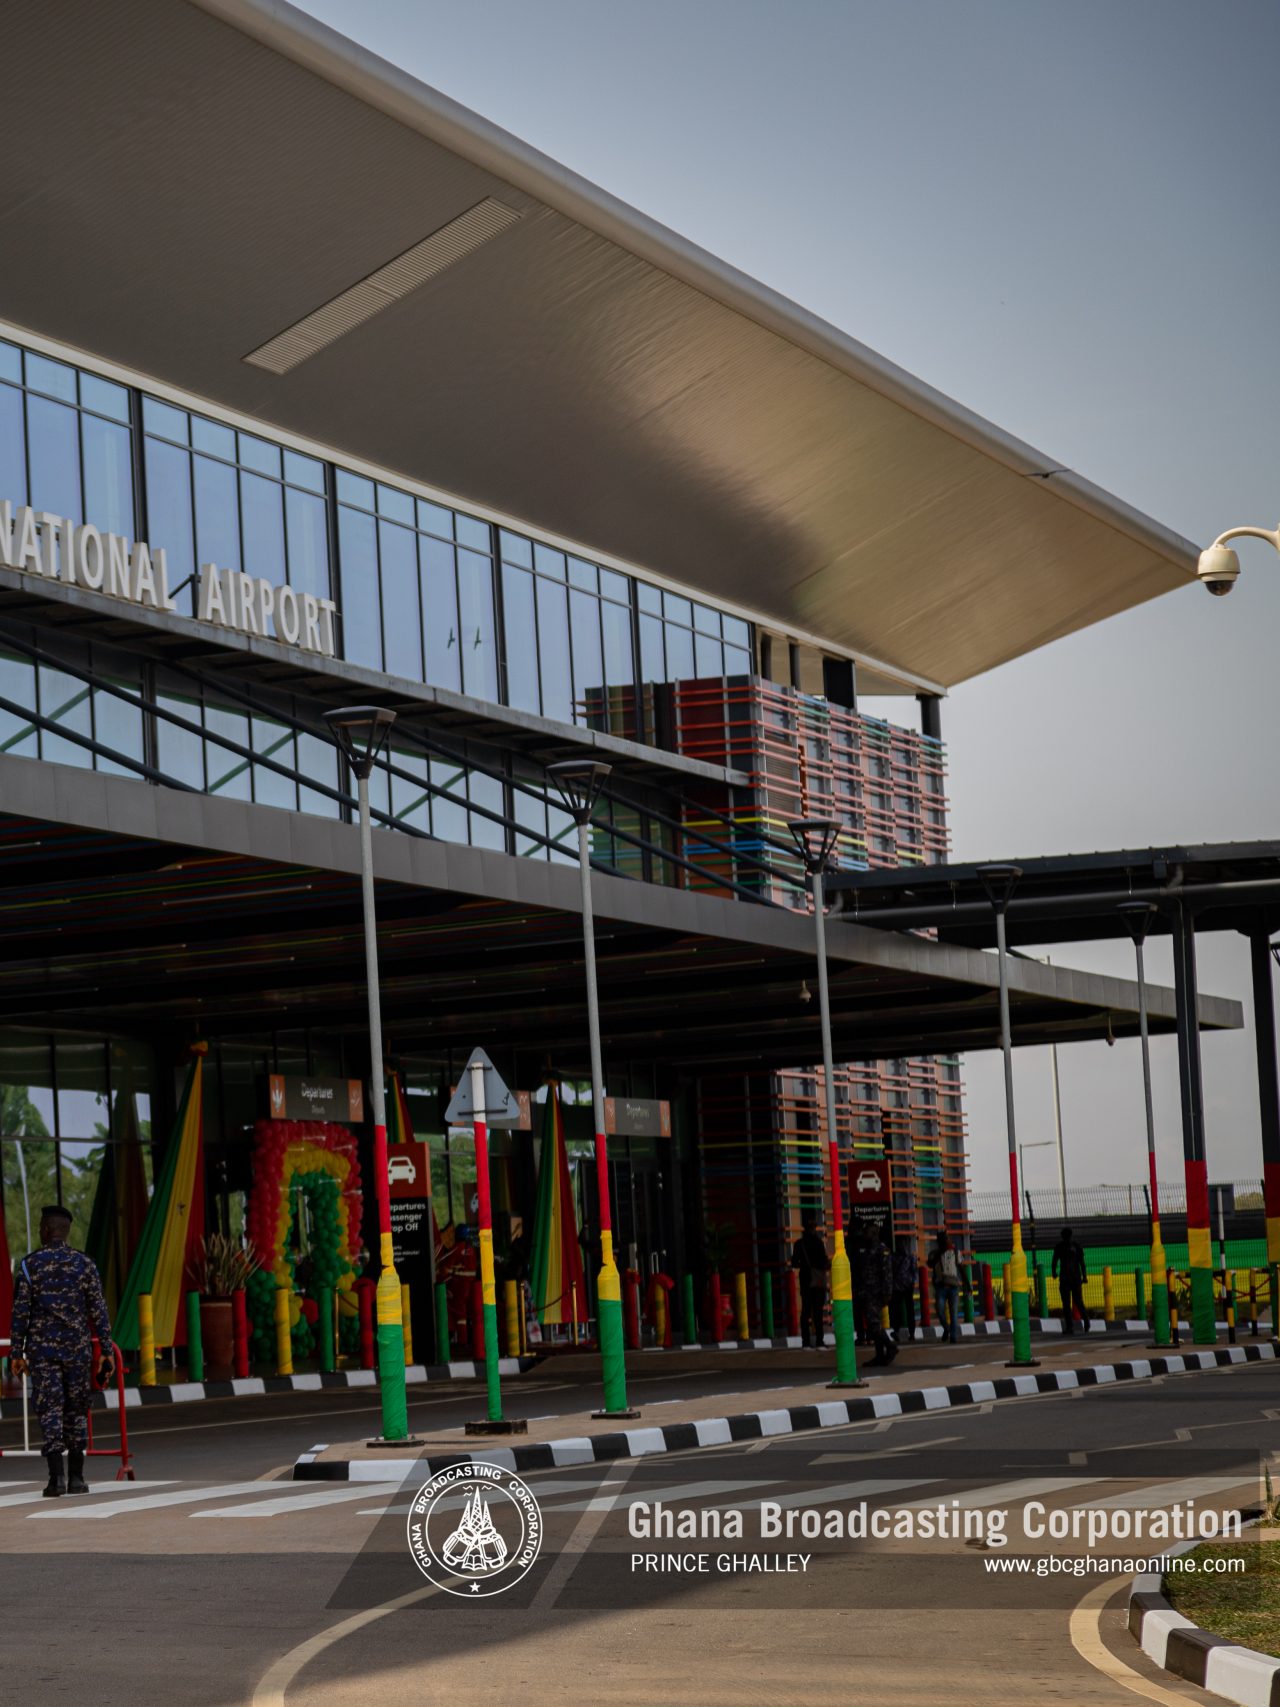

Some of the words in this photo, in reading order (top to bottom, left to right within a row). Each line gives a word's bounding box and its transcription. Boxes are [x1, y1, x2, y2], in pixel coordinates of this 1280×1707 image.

[198, 562, 336, 656] AIRPORT
[390, 1202, 426, 1212] epartures
[405, 1222, 419, 1232] Off
